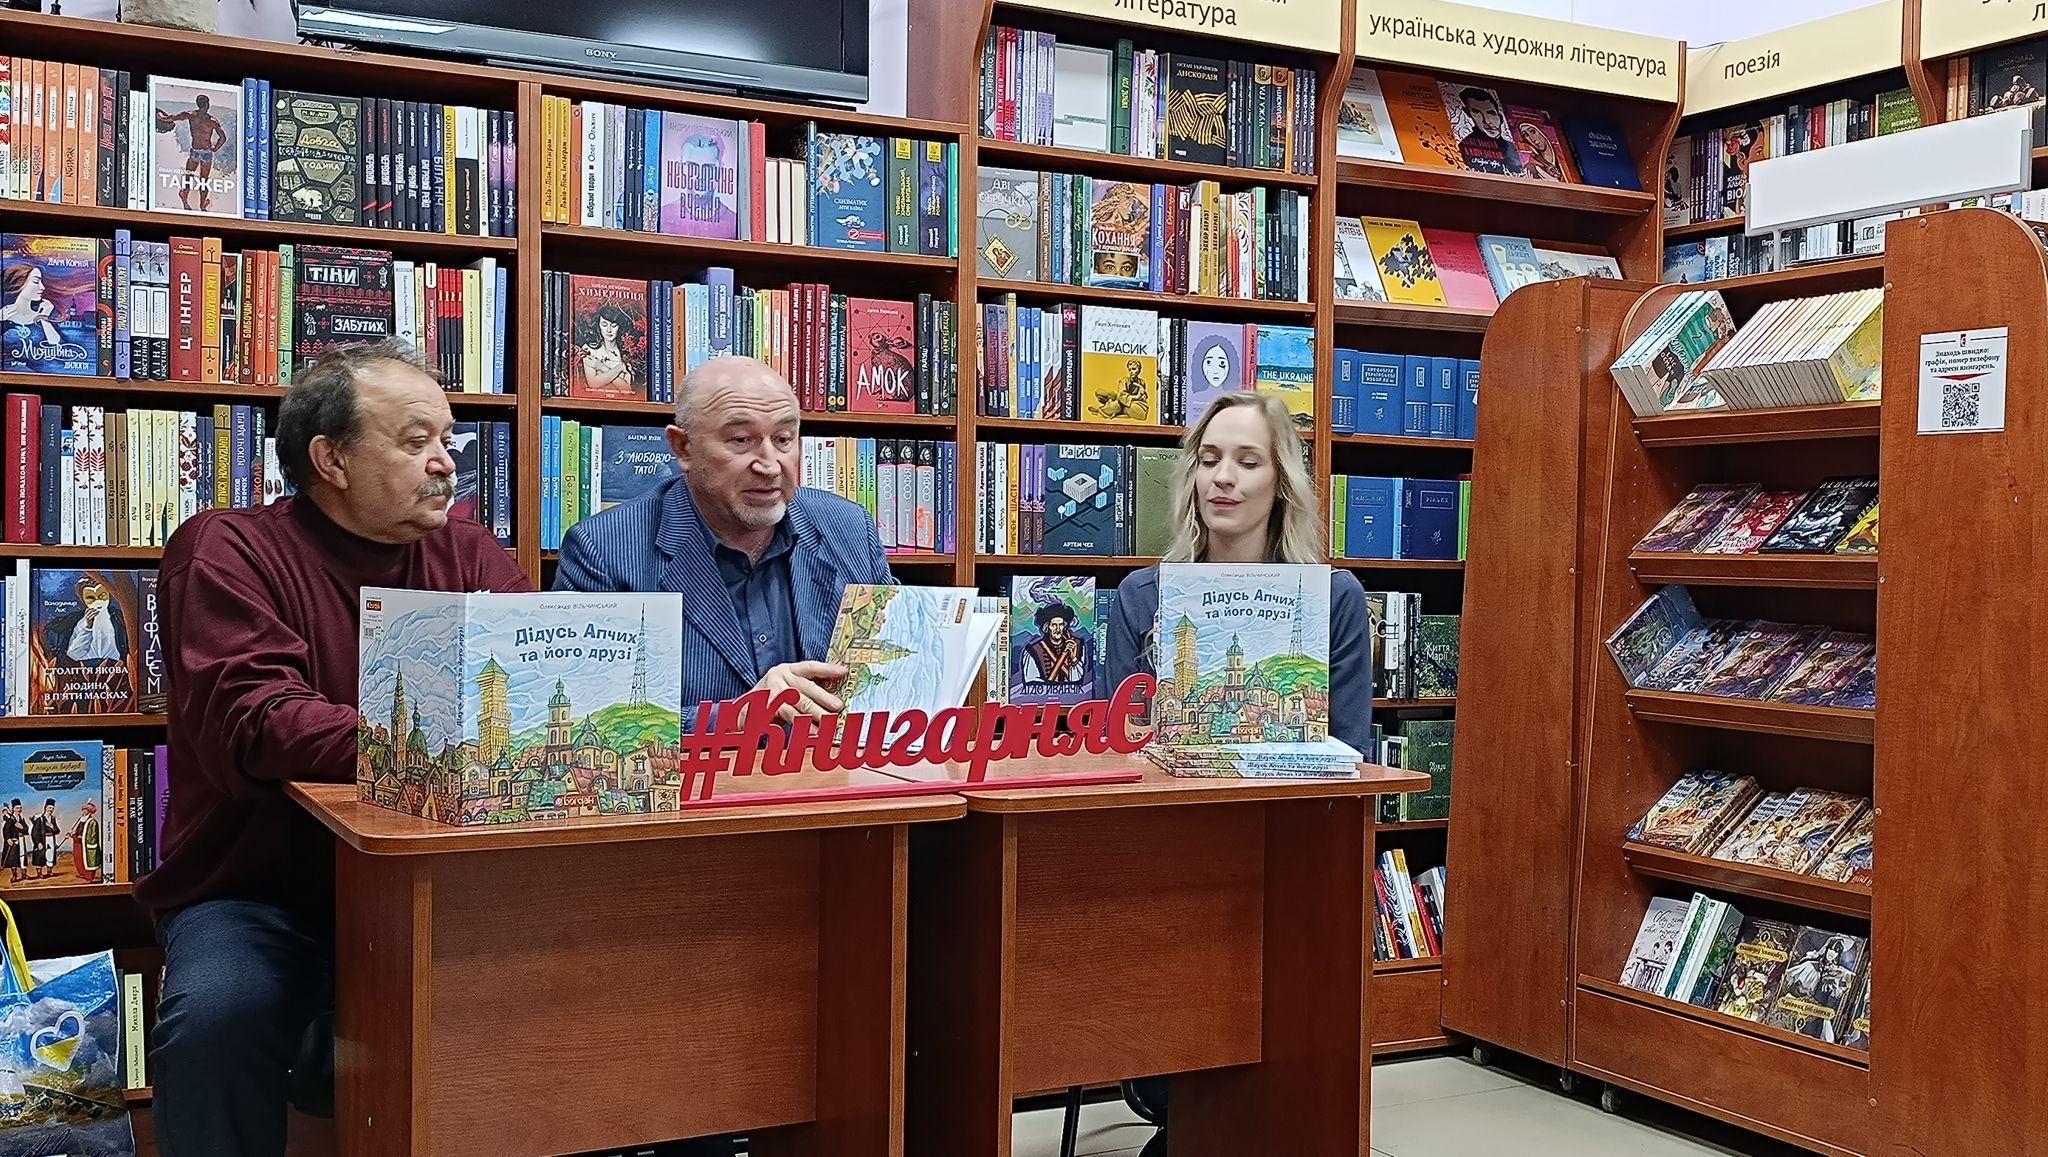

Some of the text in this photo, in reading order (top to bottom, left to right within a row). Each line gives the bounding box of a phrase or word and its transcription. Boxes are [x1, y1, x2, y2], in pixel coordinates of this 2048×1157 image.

[1370, 13, 1667, 77] українська художня література
[585, 47, 618, 60] SONY
[1723, 50, 1781, 80] поезія
[1176, 70, 1218, 81] ДИСКОРДІЯ
[1258, 85, 1266, 127] ЧУЖА ГРА
[588, 112, 596, 141] Ольжич
[301, 134, 340, 148] Довга
[588, 144, 596, 162] Олег
[303, 161, 340, 171] ГОДИНА
[159, 174, 236, 194] ТАНЖЕР
[433, 156, 443, 206] БІЛА НІЧ
[991, 177, 1010, 191] ДВІ
[587, 193, 595, 218] Вибрані
[1091, 227, 1137, 247] КОХАННЯ
[47, 257, 89, 268] ДАРА КОРНІЙ
[578, 287, 645, 301] ХИМЕРНИЦЯ
[180, 272, 192, 350] ЦВІНГЕР
[334, 318, 385, 333] ЗАБУТИХ
[1091, 340, 1147, 355] ТАРАСИК
[1962, 347, 1989, 355] швидко:
[1925, 354, 2000, 367] графік, номер телефону
[1262, 370, 1314, 383] THE UKRAINE
[1938, 366, 1959, 374] адреси
[856, 363, 910, 401] АМОК
[236, 412, 245, 466] КЛЮЧІ МАРІЇ
[614, 450, 624, 464] З
[633, 464, 658, 475] ТАТО!
[884, 467, 892, 500] СОФІЯ
[903, 467, 912, 500] СОФІЯ
[923, 470, 931, 502] СОФІЯ
[1201, 588, 1297, 608] Дідусь Апчих
[539, 602, 619, 610] Олександр ВІЛЬЧИНСЬКИЙ
[1205, 606, 1291, 620] та його друзі
[514, 622, 638, 647] Дідусь Апчих
[1424, 641, 1450, 653] Життя
[519, 647, 632, 663] та його друзі
[1426, 651, 1448, 662] Марії
[44, 667, 129, 675] СТОЛІТТЯ ЯКОВА
[63, 682, 109, 691] ЛЮДИНА
[1020, 685, 1045, 696] ДІДО
[44, 691, 128, 701] В П'ЯТИ МАСКАХ
[680, 671, 1158, 801] #КнигарняЄ
[1255, 753, 1276, 762] Дідусь
[1277, 753, 1294, 761] Апчих
[1304, 754, 1319, 762] його
[1320, 754, 1337, 762] друзі
[1246, 762, 1267, 770] Дідусь
[1269, 762, 1285, 770] Апчих
[1295, 763, 1311, 771] його
[1312, 763, 1329, 771] друзі
[1254, 770, 1274, 779] Дідусь
[1275, 770, 1292, 778] Апчих
[1302, 771, 1318, 779] його
[1318, 771, 1335, 779] друзі
[131, 1011, 139, 1032] Микола
